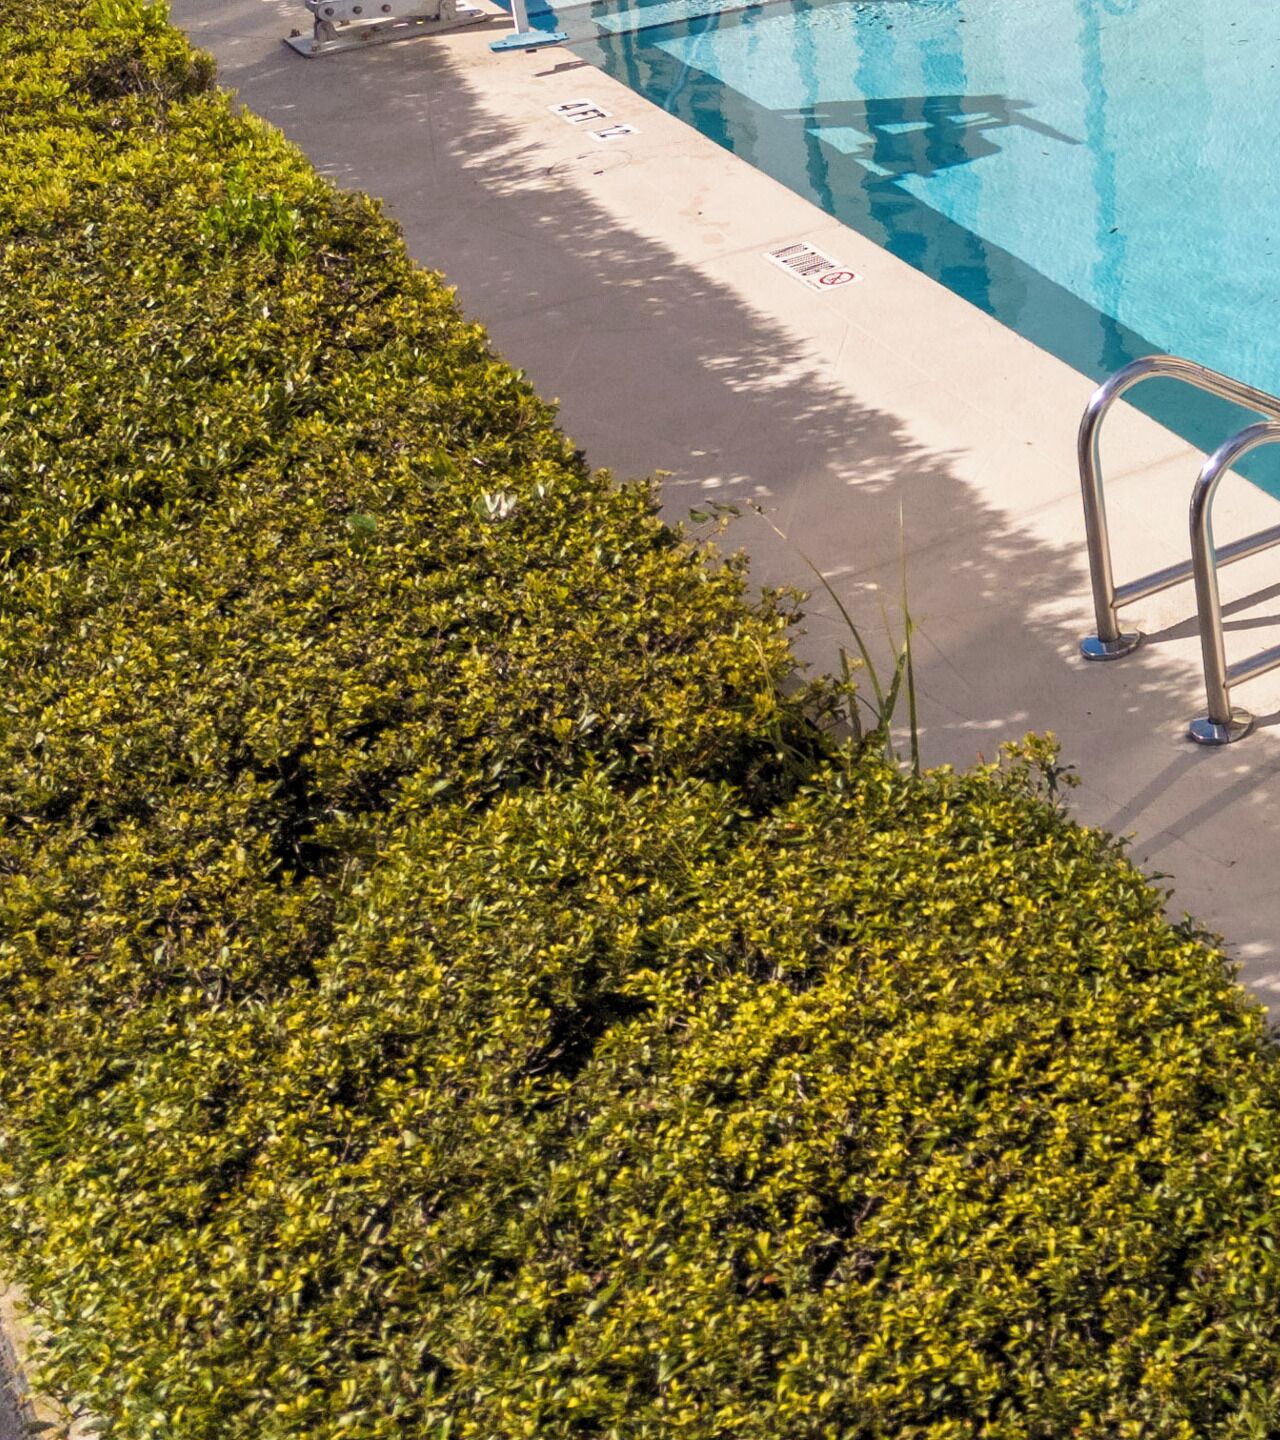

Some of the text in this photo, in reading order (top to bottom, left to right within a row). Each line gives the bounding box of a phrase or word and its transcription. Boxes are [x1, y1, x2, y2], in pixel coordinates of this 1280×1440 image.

[558, 103, 607, 123] 4 FT
[769, 243, 836, 277] NO DIVING
